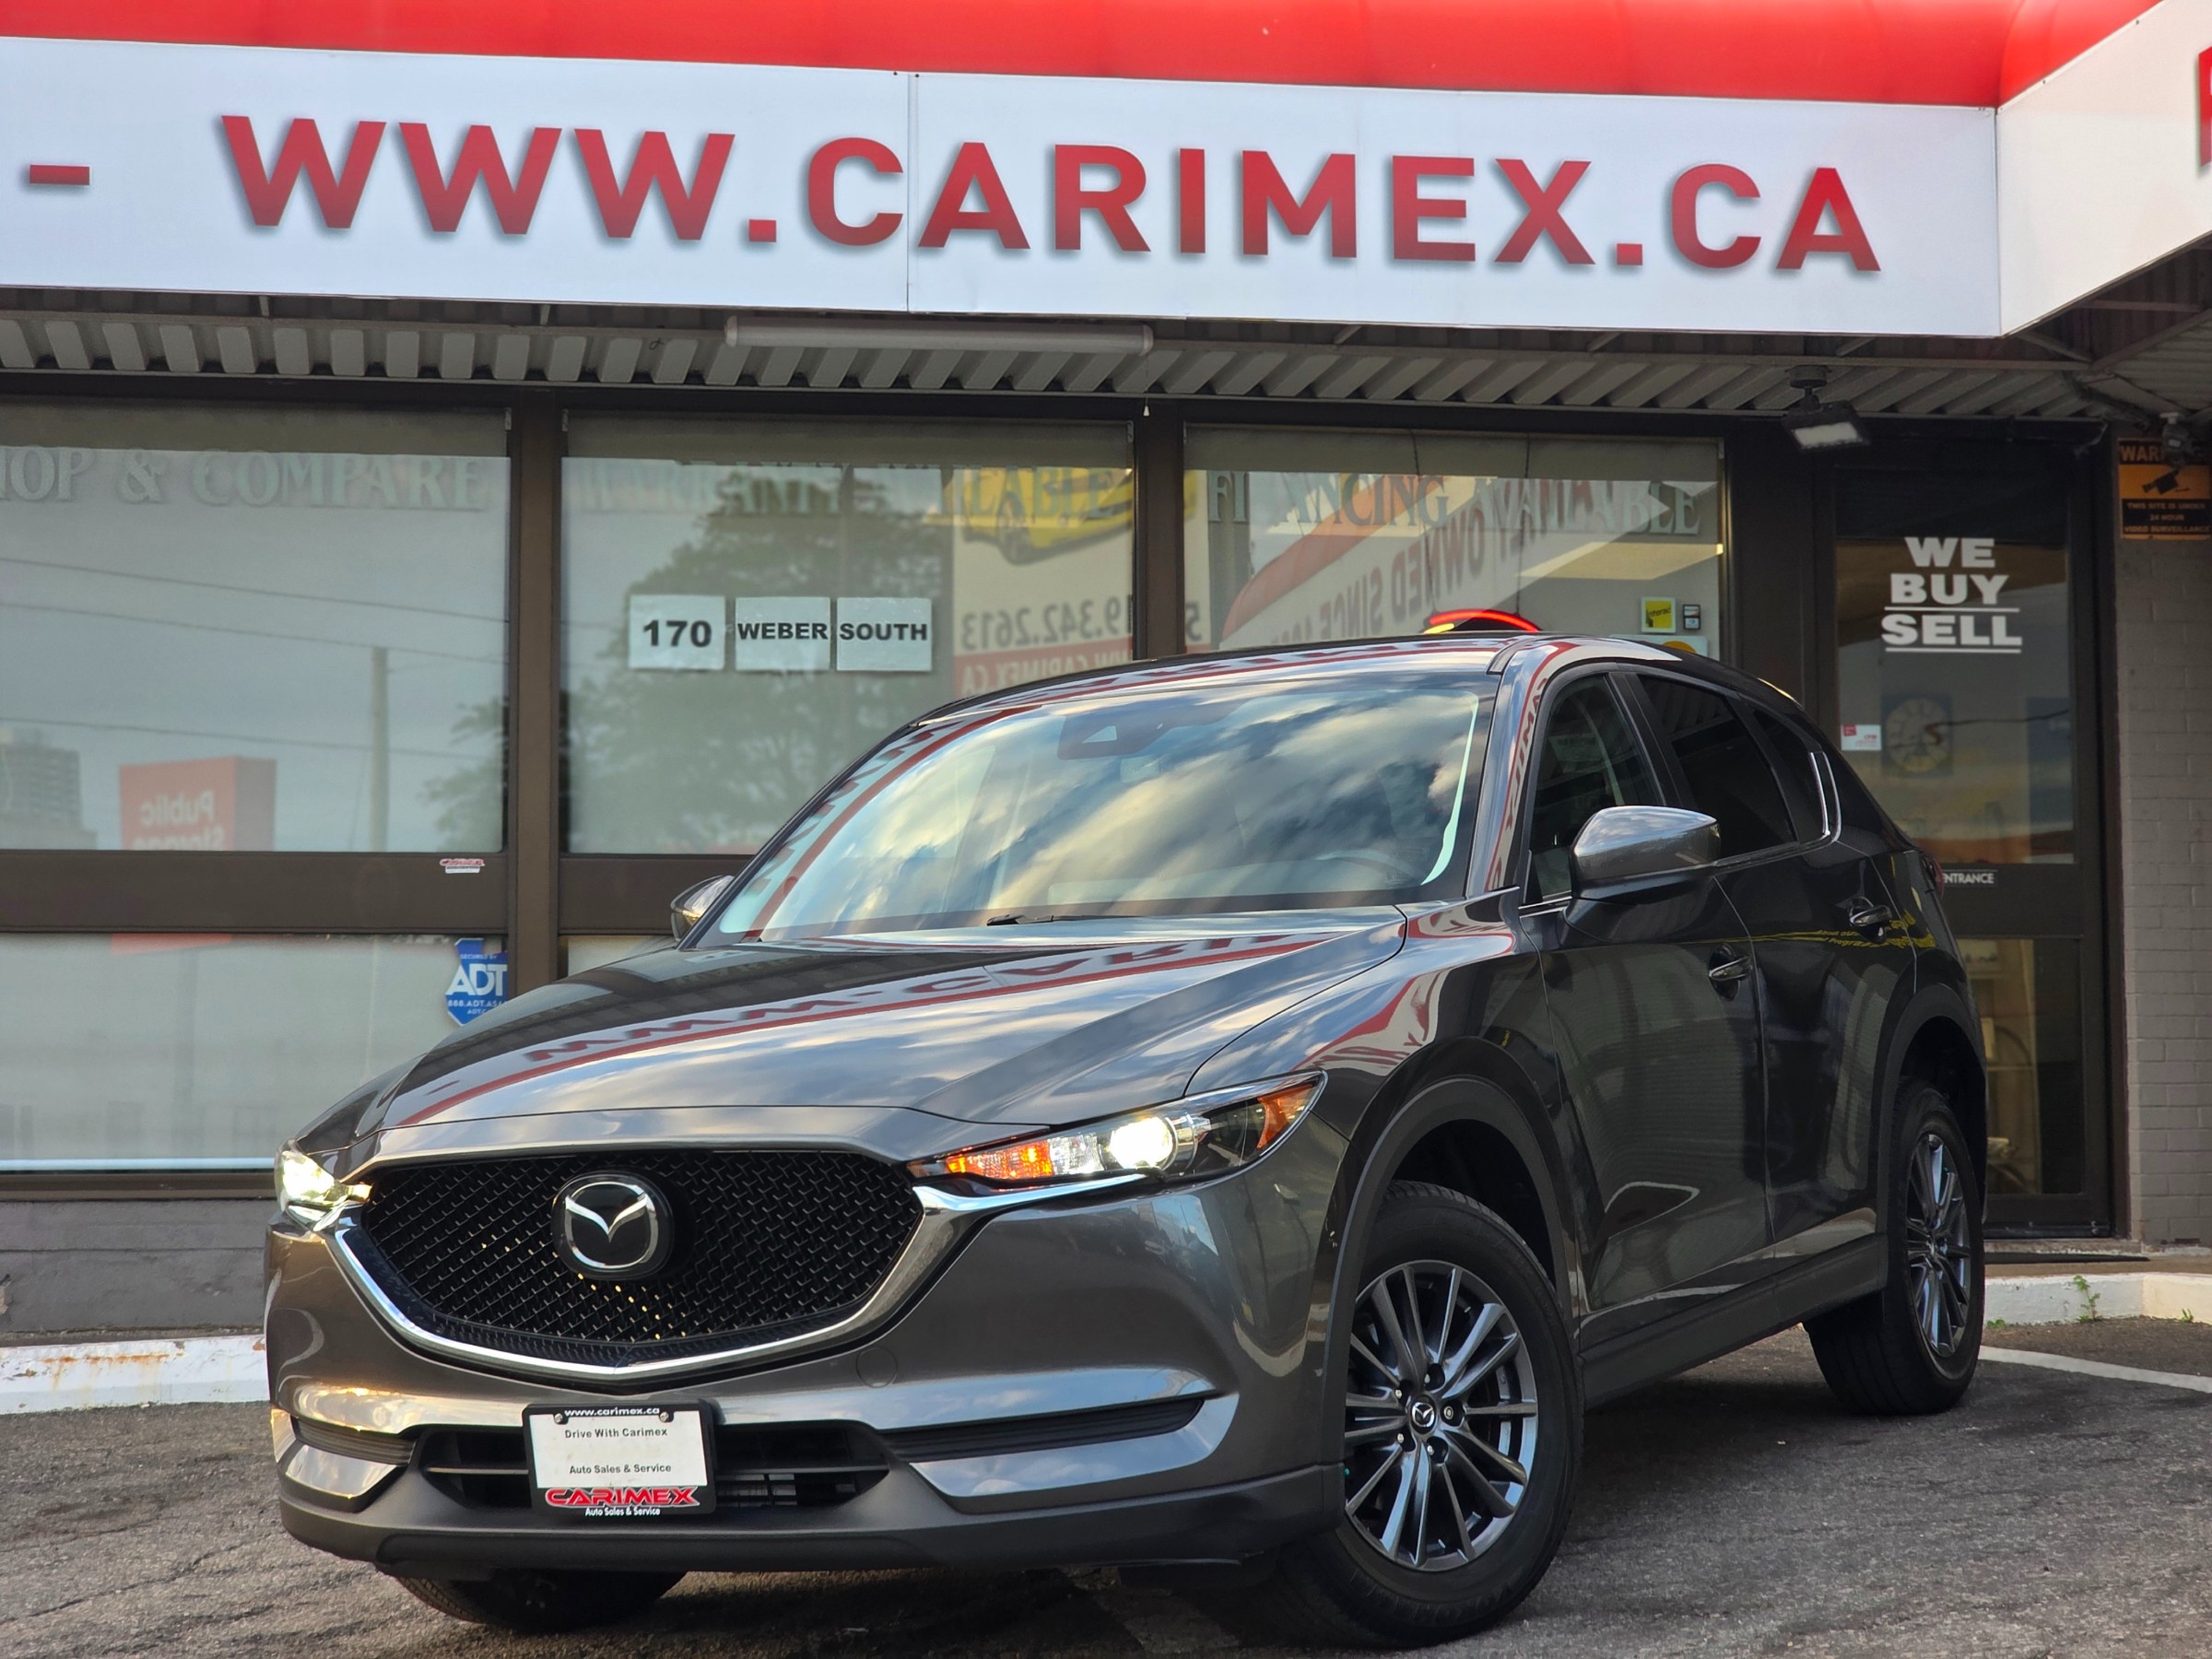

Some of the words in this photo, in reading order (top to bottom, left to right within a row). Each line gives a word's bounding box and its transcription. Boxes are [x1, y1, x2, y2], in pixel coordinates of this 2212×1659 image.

[221, 114, 1882, 273] WWW.CARIMEX.CA
[1206, 471, 1450, 527] FIANCING
[1905, 536, 1995, 568] WE
[1890, 573, 2009, 605] BUY
[642, 620, 712, 647] 170
[738, 622, 828, 640] WEBER
[840, 623, 927, 641] SOUTH
[1881, 615, 2022, 646] SELL
[445, 963, 508, 996] ADT
[564, 1406, 661, 1418] www.carimex.ca
[565, 1430, 593, 1439] Drive
[594, 1428, 619, 1438] With
[622, 1428, 668, 1438] Carimex
[570, 1465, 592, 1475] Auto
[594, 1465, 621, 1474] Sales
[623, 1464, 631, 1473] &
[634, 1464, 672, 1473] Service
[546, 1487, 700, 1507] CARIMEX
[585, 1507, 604, 1517] Auto
[605, 1507, 625, 1516] Sales
[627, 1507, 632, 1516] &
[633, 1506, 661, 1516] Service
